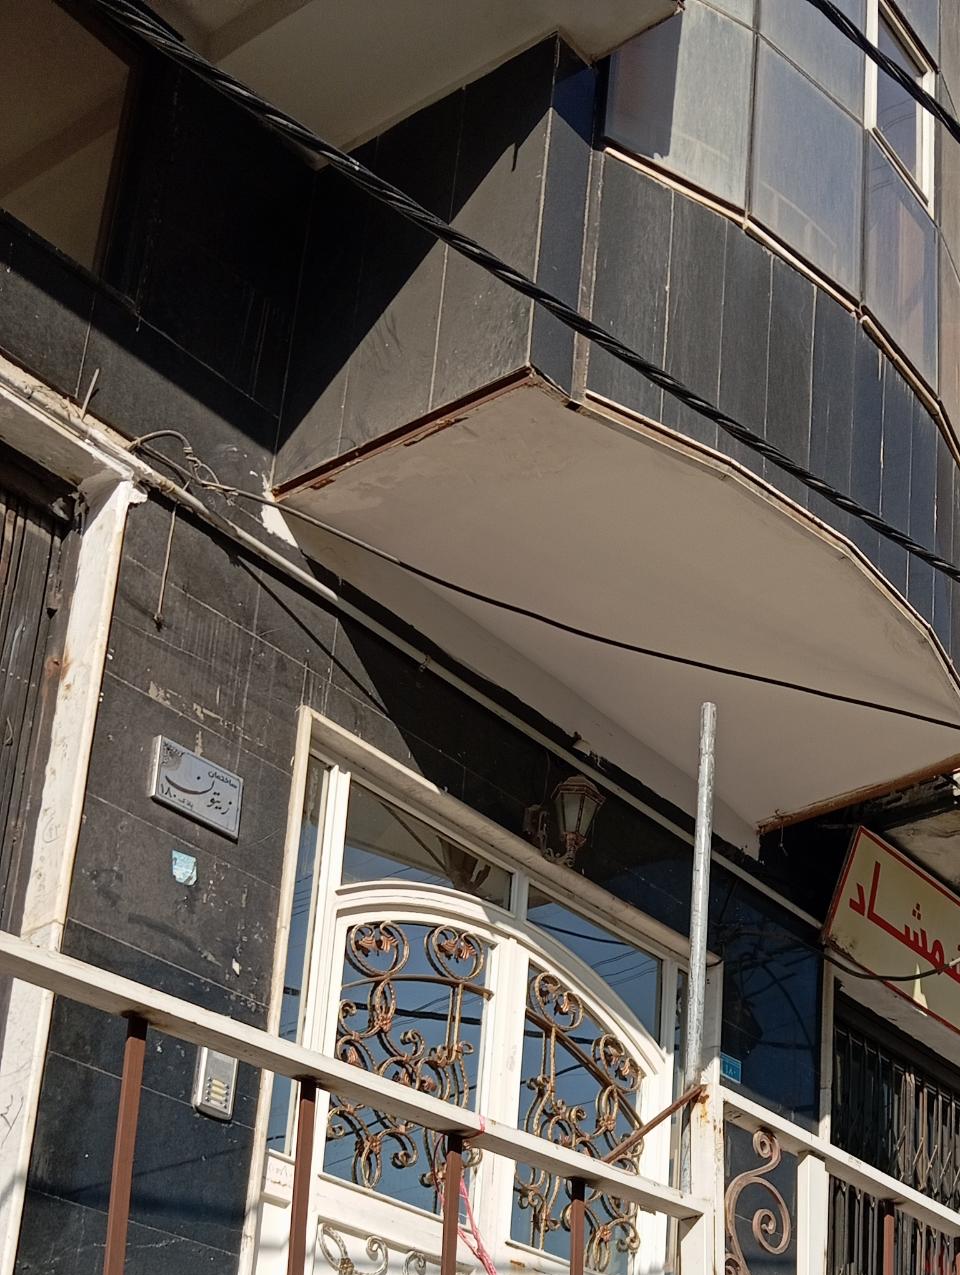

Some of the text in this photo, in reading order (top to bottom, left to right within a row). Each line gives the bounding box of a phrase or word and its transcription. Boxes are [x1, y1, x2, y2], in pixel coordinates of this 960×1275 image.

[207, 770, 238, 790] ساختمان
[160, 783, 177, 799] ۱۸۰
[165, 775, 232, 815] زیتون
